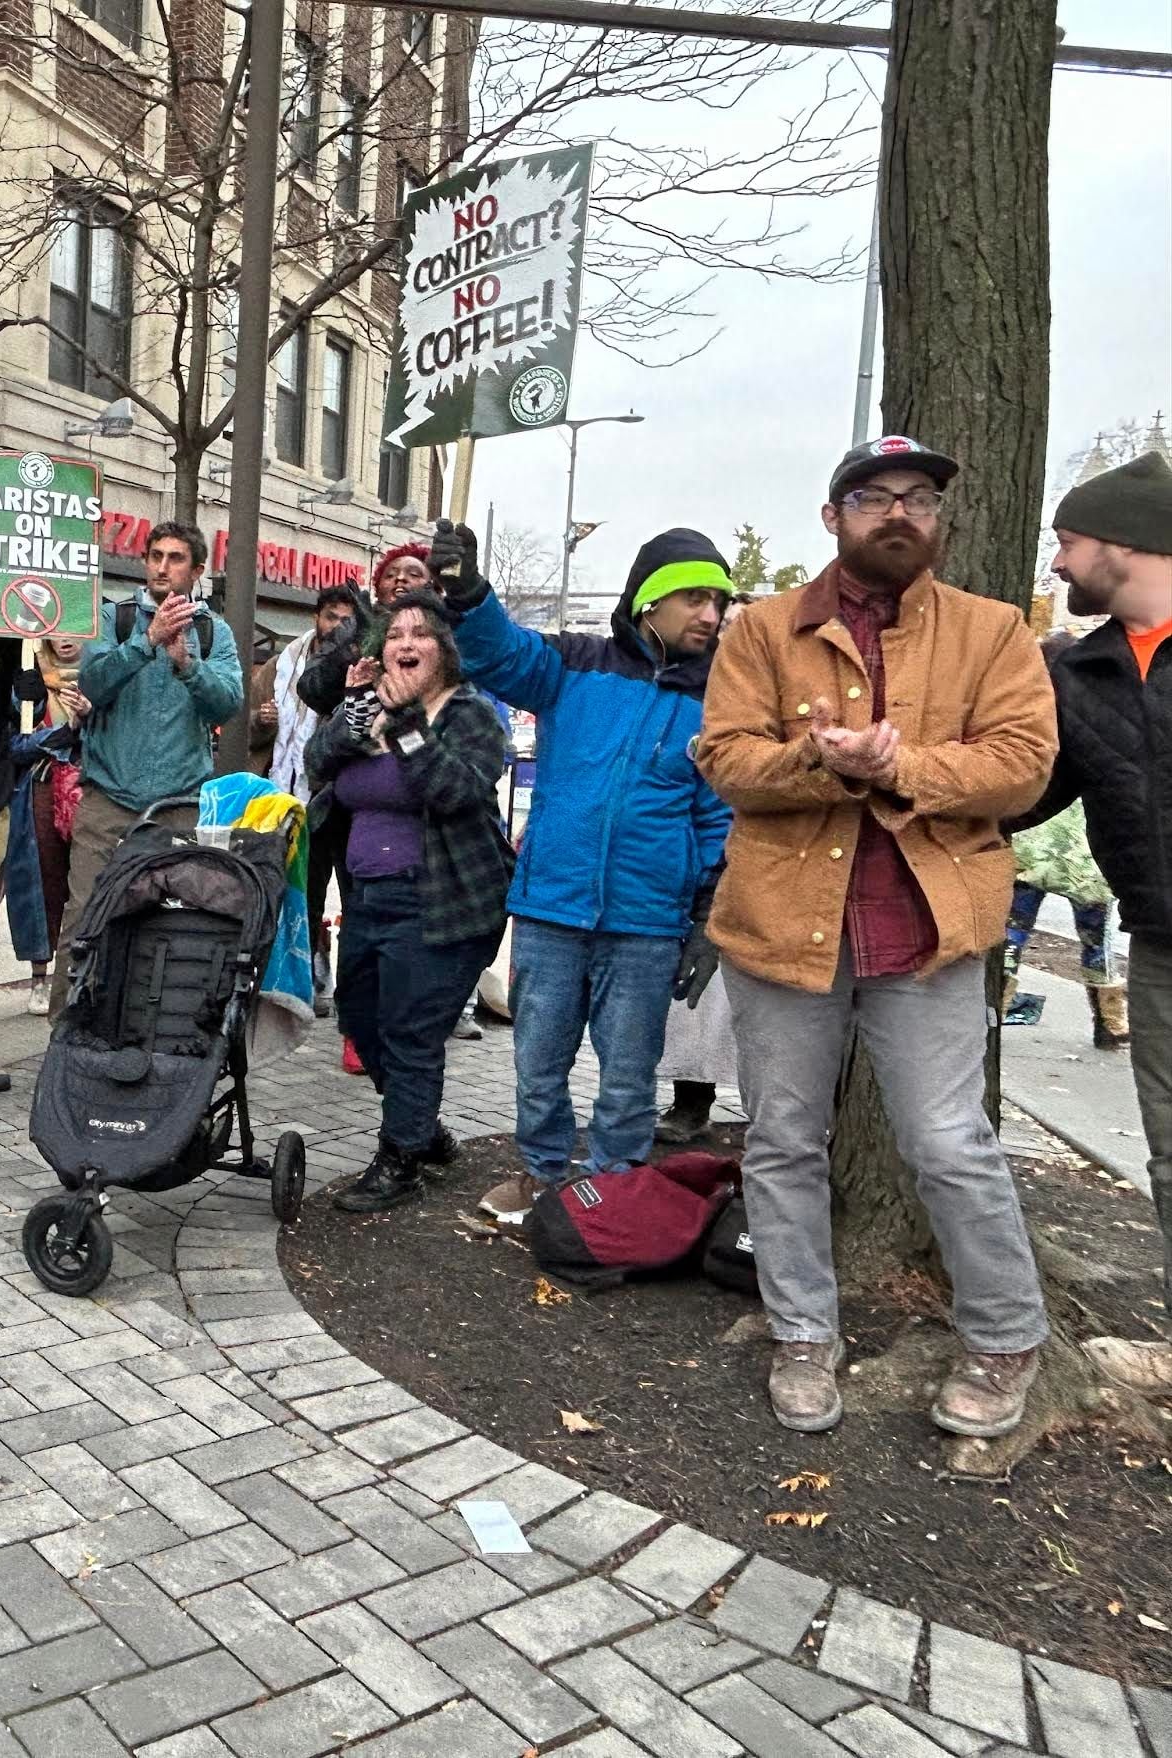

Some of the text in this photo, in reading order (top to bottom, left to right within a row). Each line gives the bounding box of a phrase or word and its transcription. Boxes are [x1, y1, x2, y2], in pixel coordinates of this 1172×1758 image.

[454, 194, 499, 241] NO
[413, 199, 566, 293] CONTRACT?
[454, 274, 501, 320] NO
[416, 279, 555, 377] COFFEE!
[15, 513, 52, 537] ON
[304, 552, 366, 591] HOUSE
